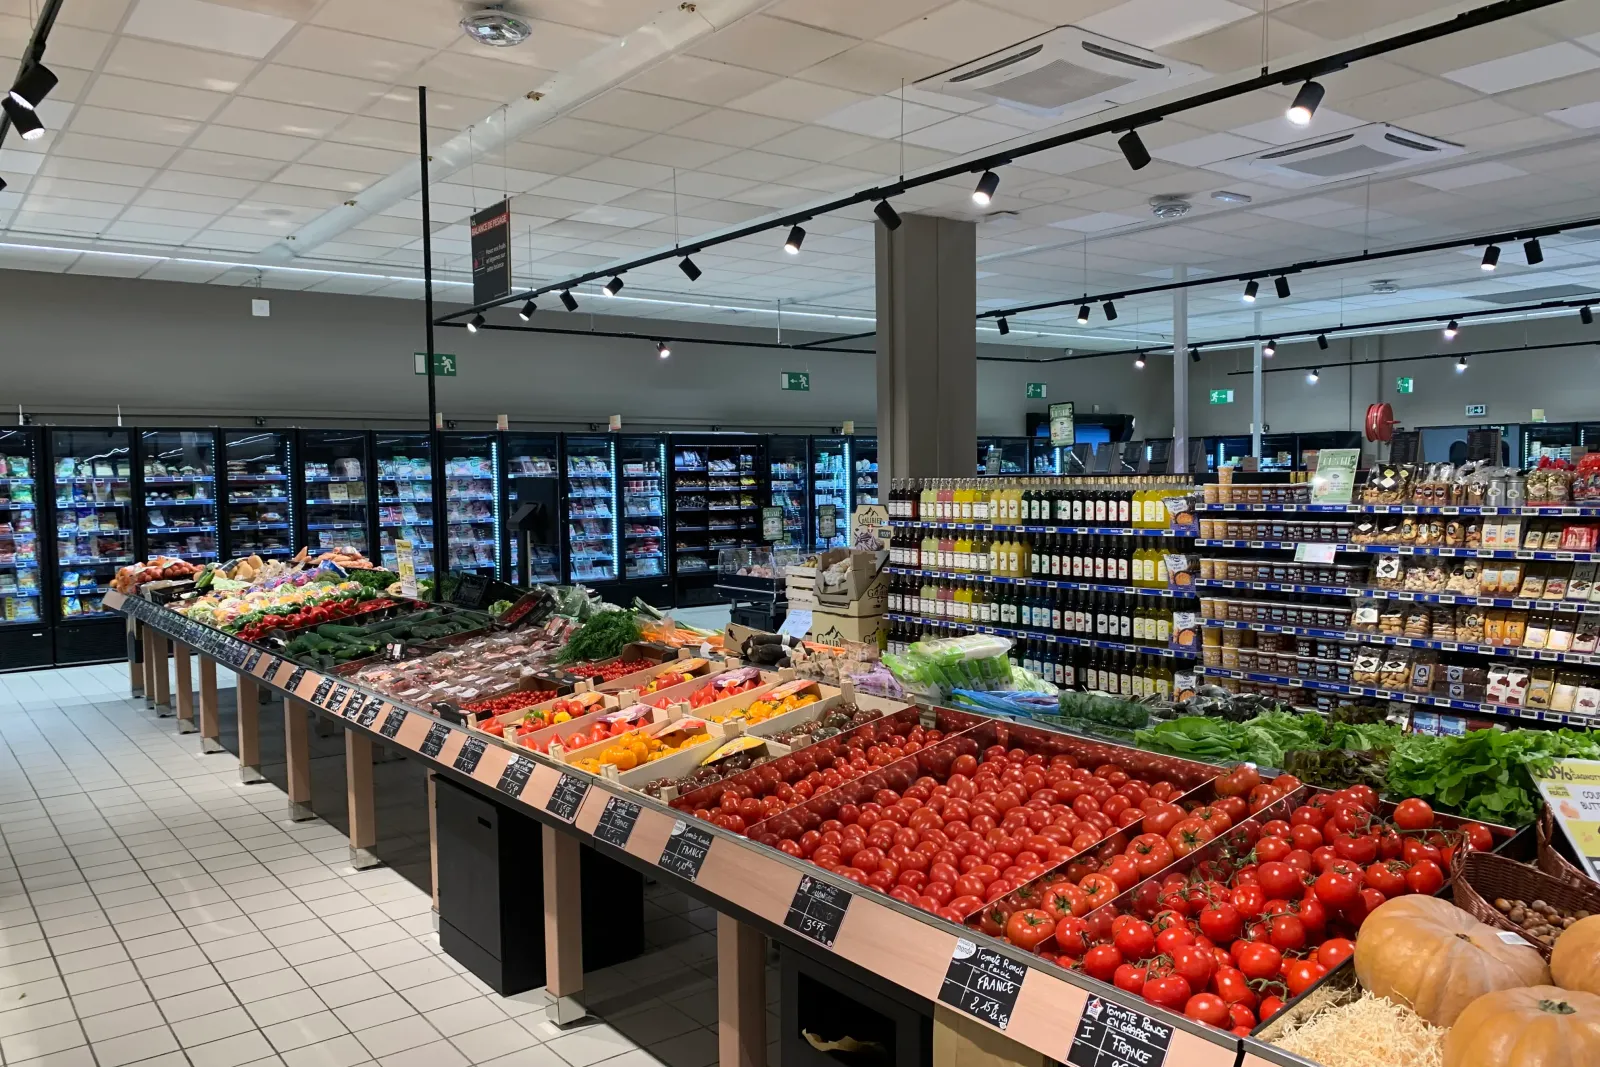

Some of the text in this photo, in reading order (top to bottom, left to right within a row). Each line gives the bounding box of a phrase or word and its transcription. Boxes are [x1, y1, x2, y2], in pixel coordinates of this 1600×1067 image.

[472, 222, 488, 236] BALANCE
[488, 220, 492, 230] DE
[492, 214, 507, 228] PESAGE
[1002, 958, 1024, 977] Ronde
[977, 974, 1014, 994] FRANCE
[1112, 1034, 1152, 1064] FRANCE
